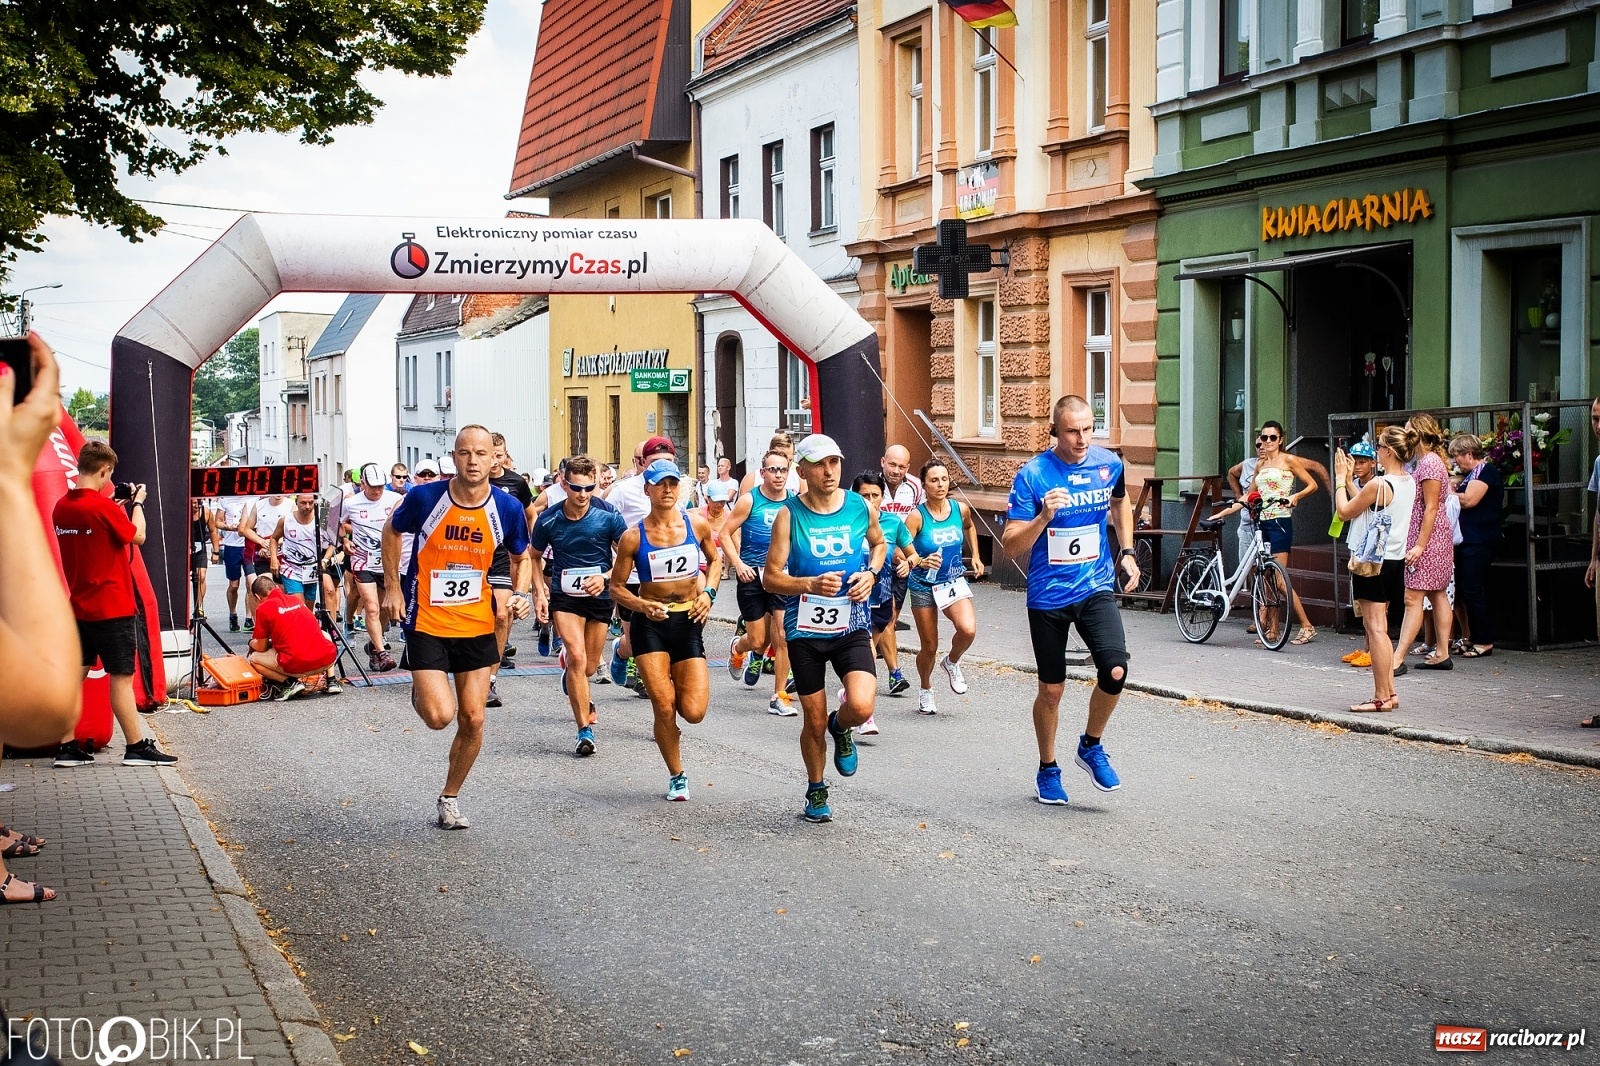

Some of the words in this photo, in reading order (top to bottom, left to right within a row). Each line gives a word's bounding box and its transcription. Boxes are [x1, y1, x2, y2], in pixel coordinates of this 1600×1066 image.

[1262, 187, 1432, 242] KWIACIARNIA
[436, 226, 538, 242] Elektroniczny
[543, 228, 593, 242] pomiar
[598, 229, 638, 240] czasu
[434, 251, 648, 280] ZmierzymyCzas.pl
[939, 255, 971, 263] APTEKA
[576, 355, 599, 376] BANK
[634, 371, 669, 379] BANKOMAT
[203, 469, 220, 495] 0
[234, 467, 271, 495] 00
[281, 465, 318, 493] 03
[444, 524, 471, 542] ULC
[437, 543, 487, 556] LANGENLOIS
[809, 533, 855, 558] bbl
[1068, 537, 1081, 556] 6
[664, 556, 688, 574] 12
[443, 580, 470, 598] 38
[948, 587, 957, 599] 4
[810, 606, 840, 626] 33
